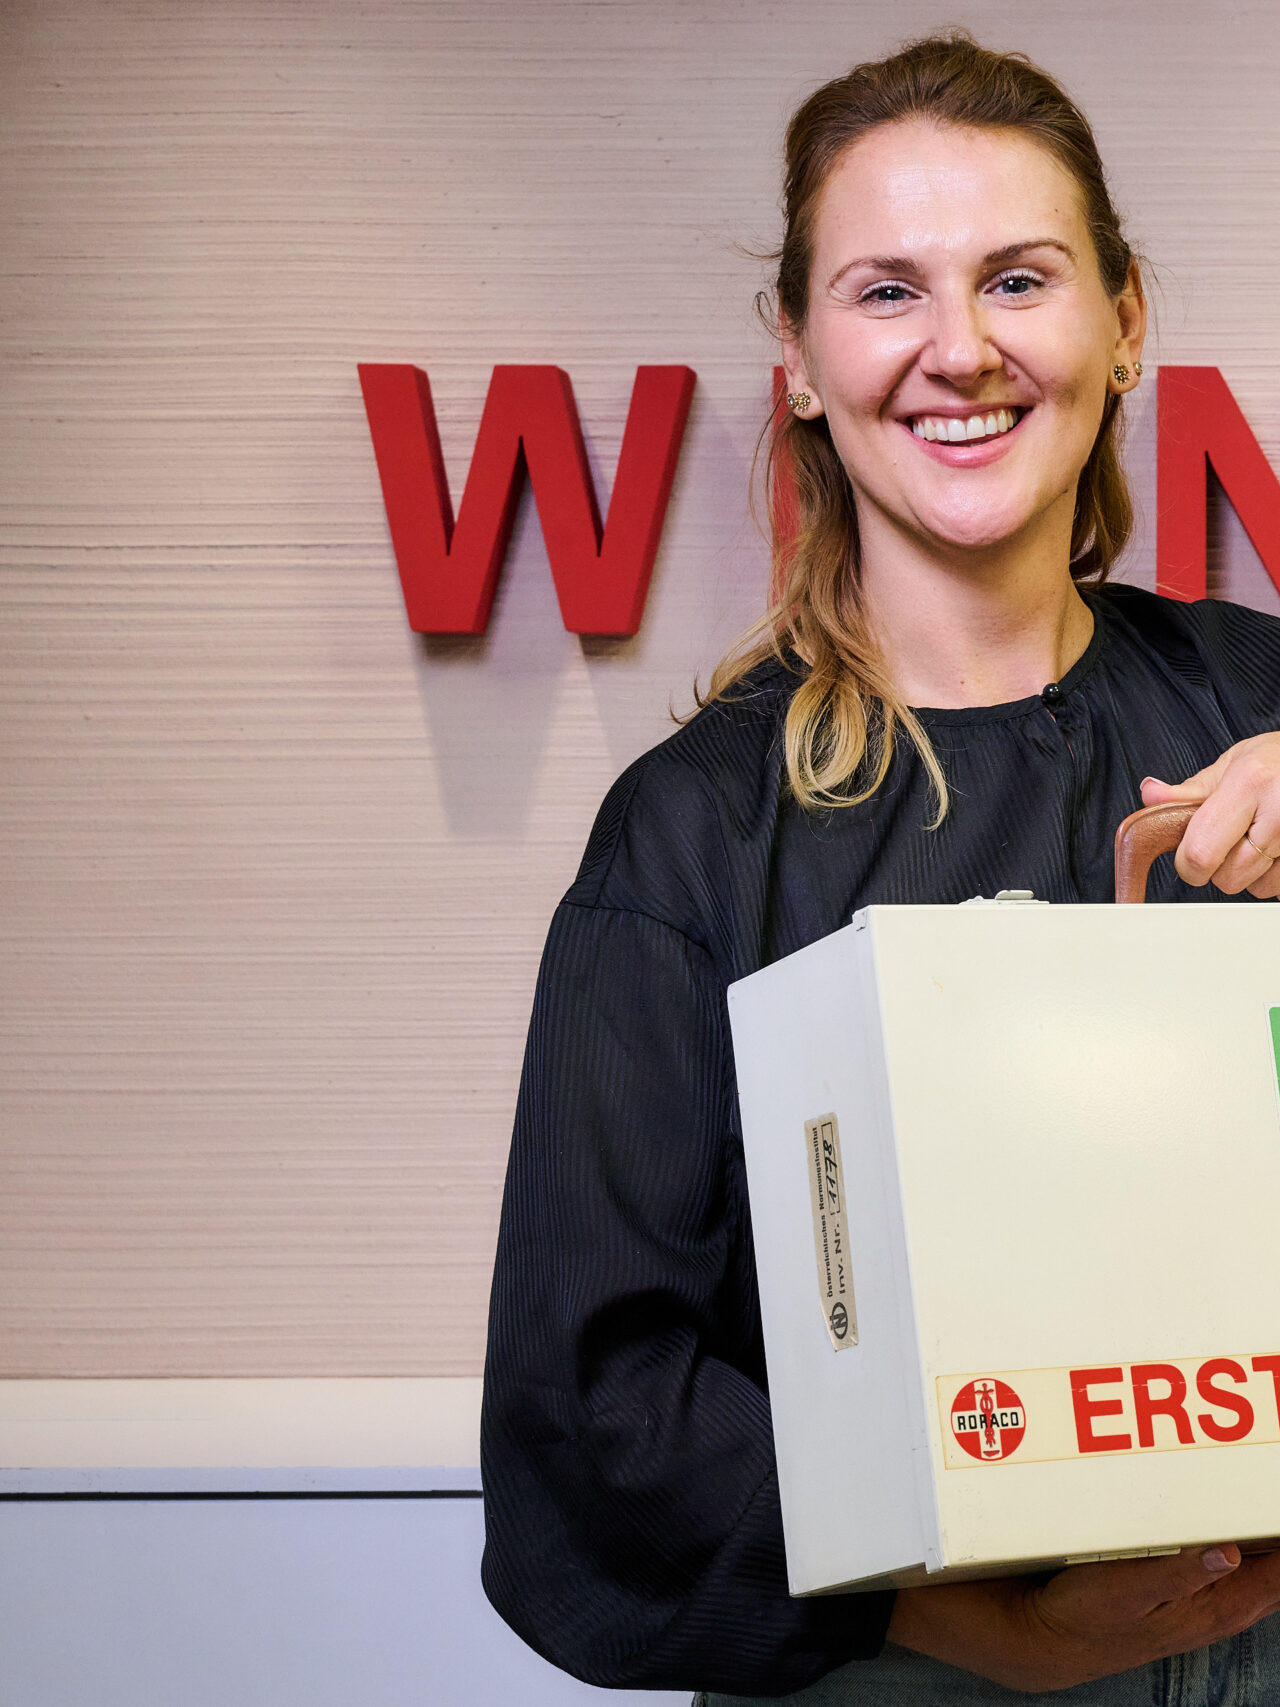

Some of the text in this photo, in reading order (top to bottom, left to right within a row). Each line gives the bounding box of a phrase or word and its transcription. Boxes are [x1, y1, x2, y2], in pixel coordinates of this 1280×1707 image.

[812, 1127, 825, 1210] Normungsinstitut
[834, 1223, 842, 1254] Nr.
[957, 1411, 1019, 1431] RORACO
